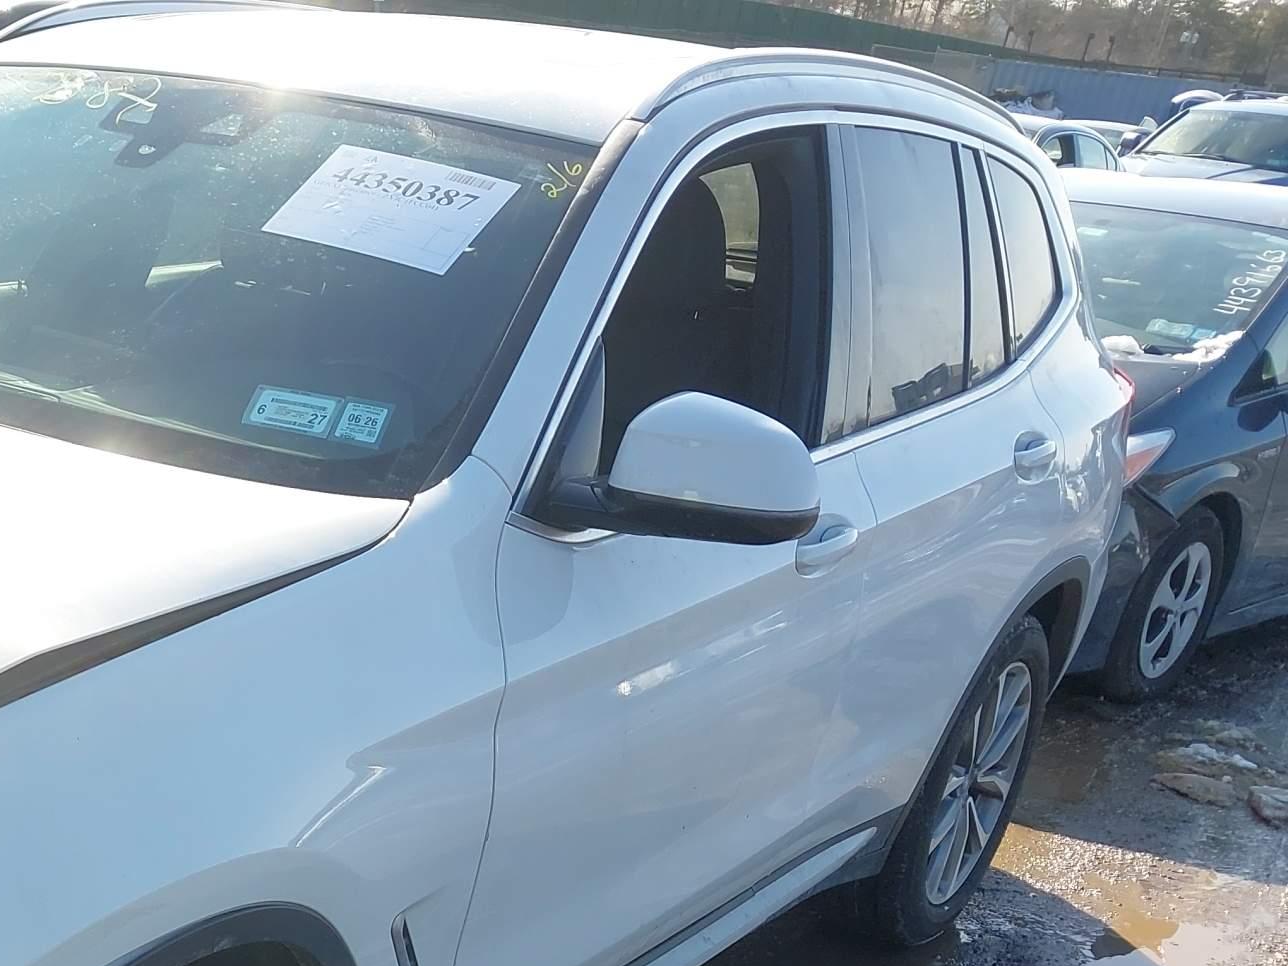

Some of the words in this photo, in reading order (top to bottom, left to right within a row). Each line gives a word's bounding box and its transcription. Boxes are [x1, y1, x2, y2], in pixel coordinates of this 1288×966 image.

[332, 167, 480, 211] 44350387
[307, 413, 328, 425] 27
[348, 413, 362, 424] 06
[364, 416, 379, 427] 26
